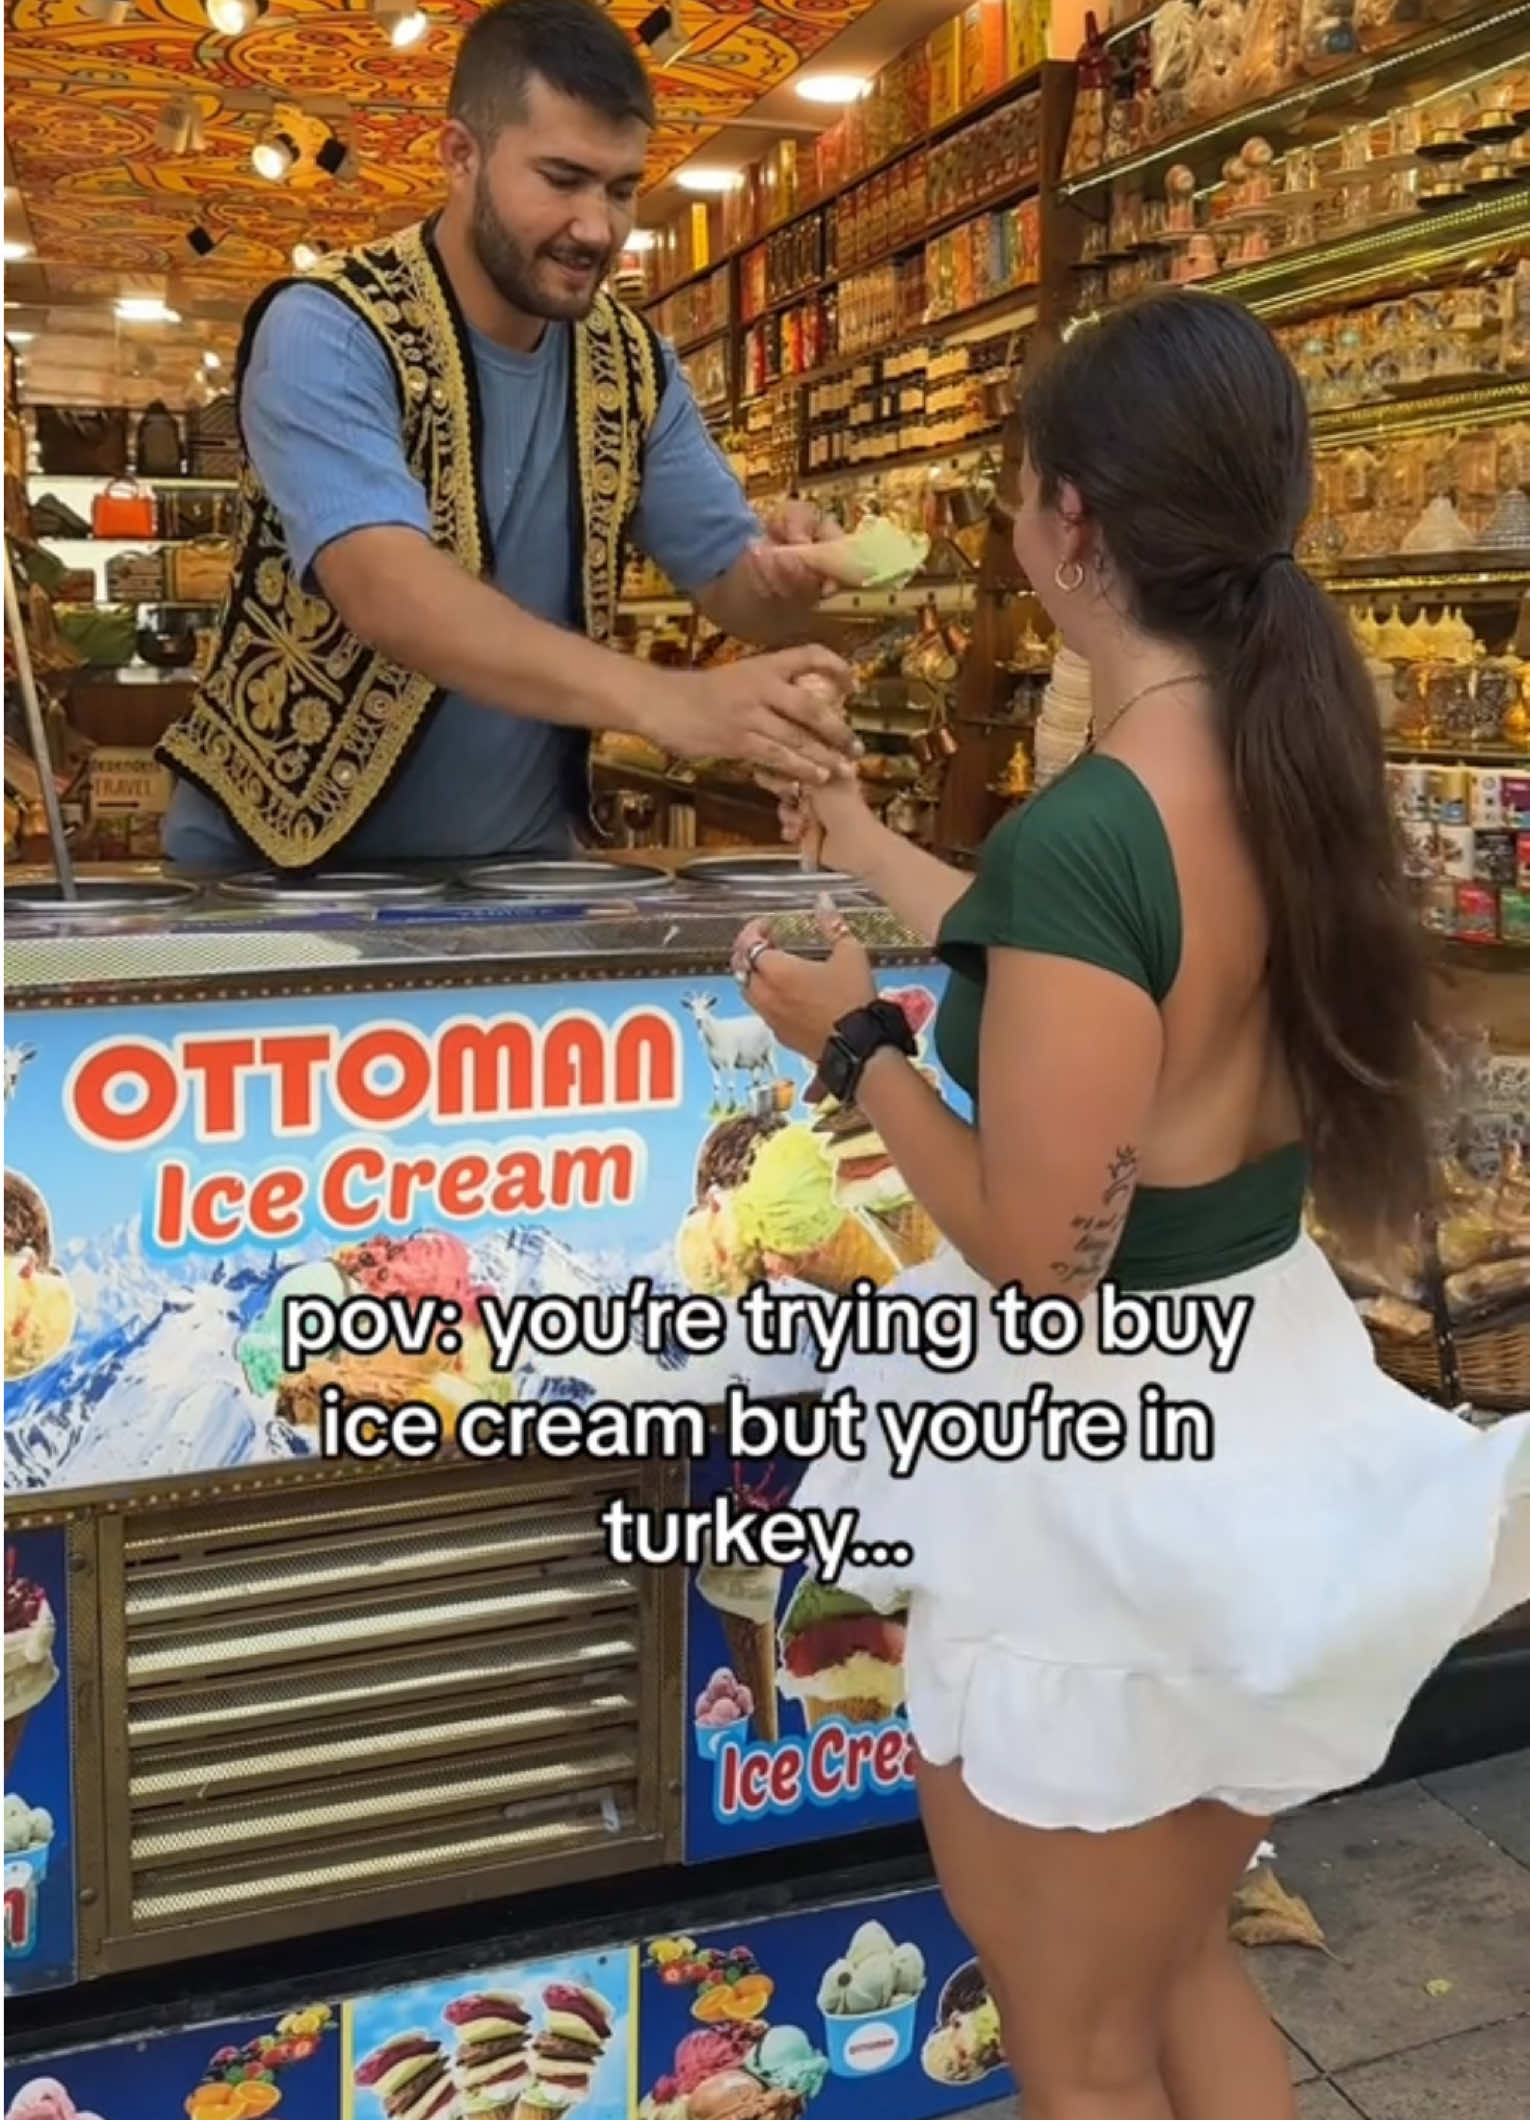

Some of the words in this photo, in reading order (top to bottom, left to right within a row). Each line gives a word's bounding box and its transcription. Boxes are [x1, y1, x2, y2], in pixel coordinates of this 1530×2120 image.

[71, 1012, 675, 1143] OTTOMAN
[156, 1164, 303, 1244] Ice
[322, 1144, 633, 1227] Cream
[722, 1746, 801, 1812] Ice
